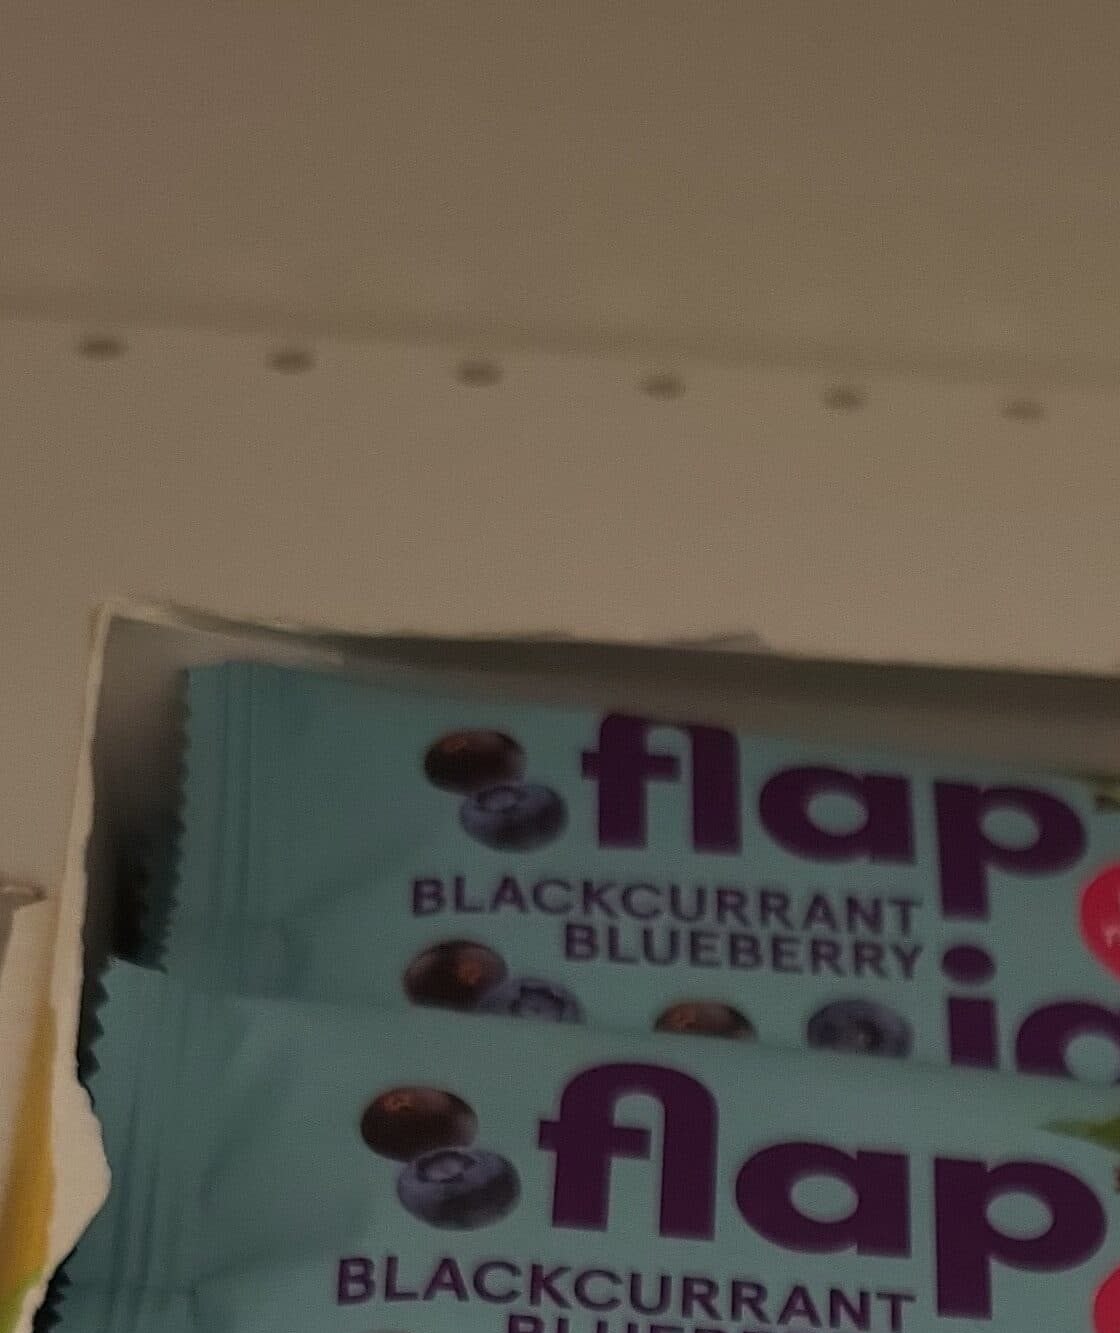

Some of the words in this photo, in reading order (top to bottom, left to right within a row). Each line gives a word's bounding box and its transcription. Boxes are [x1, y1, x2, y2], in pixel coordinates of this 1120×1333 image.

[581, 712, 1089, 921] flap
[411, 875, 925, 935] BLACKCURRANT
[563, 922, 925, 980] BLUEBERRY
[539, 1061, 1108, 1320] flap
[336, 1256, 917, 1333] BLACKCURRANT
